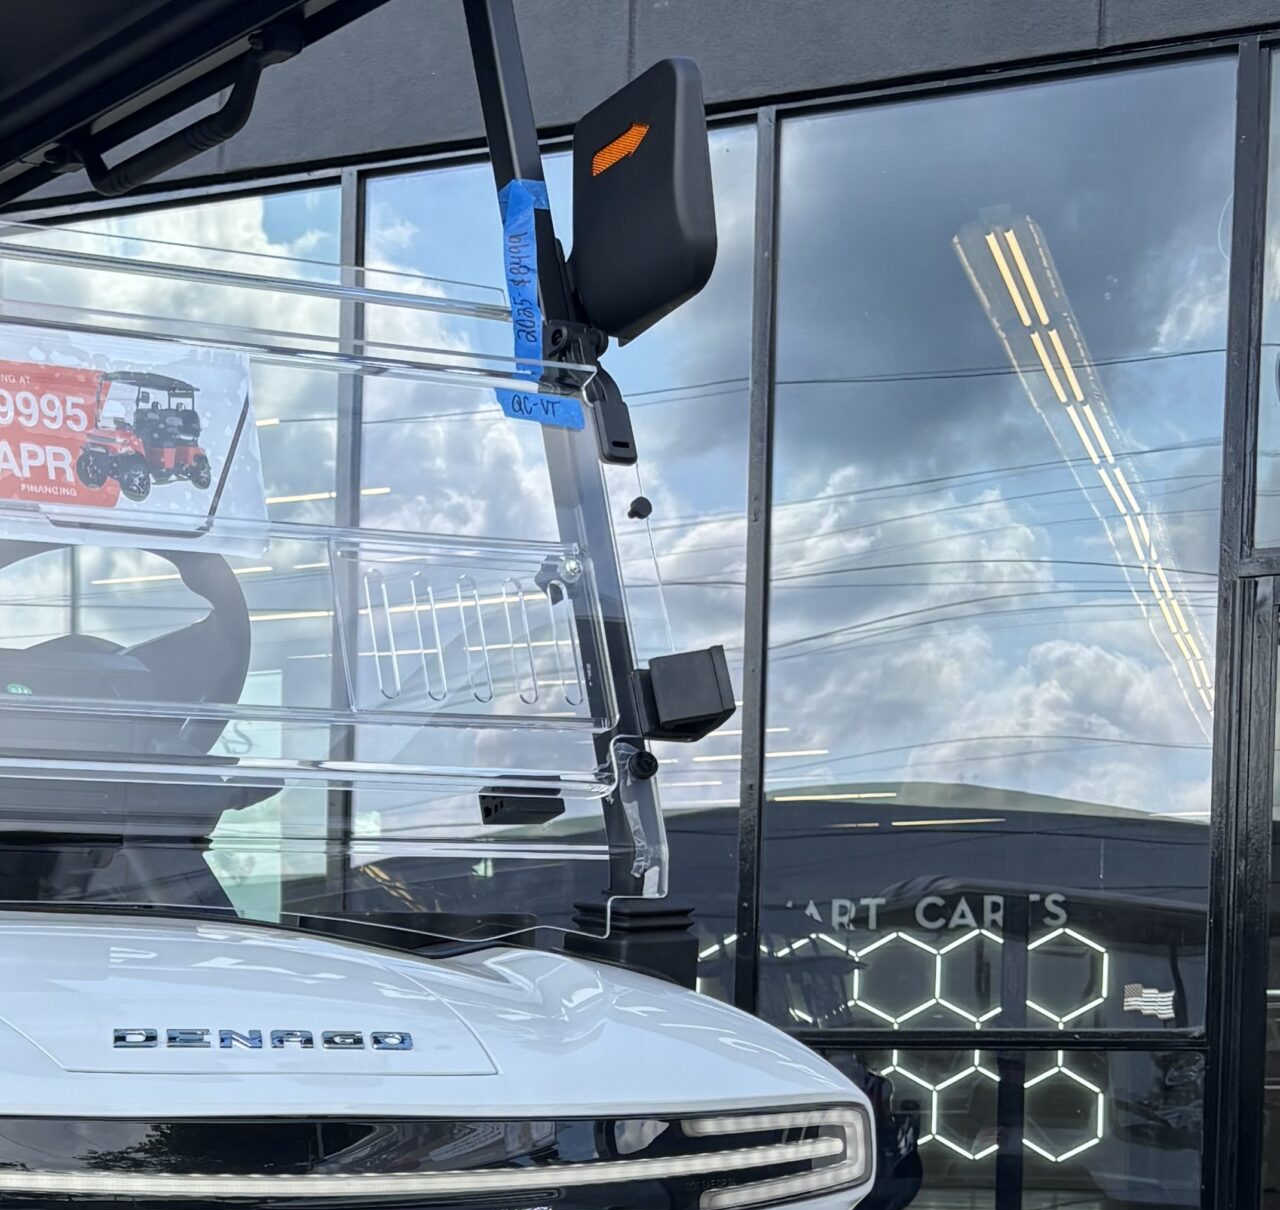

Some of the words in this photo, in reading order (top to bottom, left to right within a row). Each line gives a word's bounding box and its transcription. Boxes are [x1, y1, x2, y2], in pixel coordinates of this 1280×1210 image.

[19, 375, 31, 384] AT
[20, 483, 78, 497] FINANCING
[915, 893, 1068, 930] CARS
[113, 1028, 414, 1050] DENAGO
